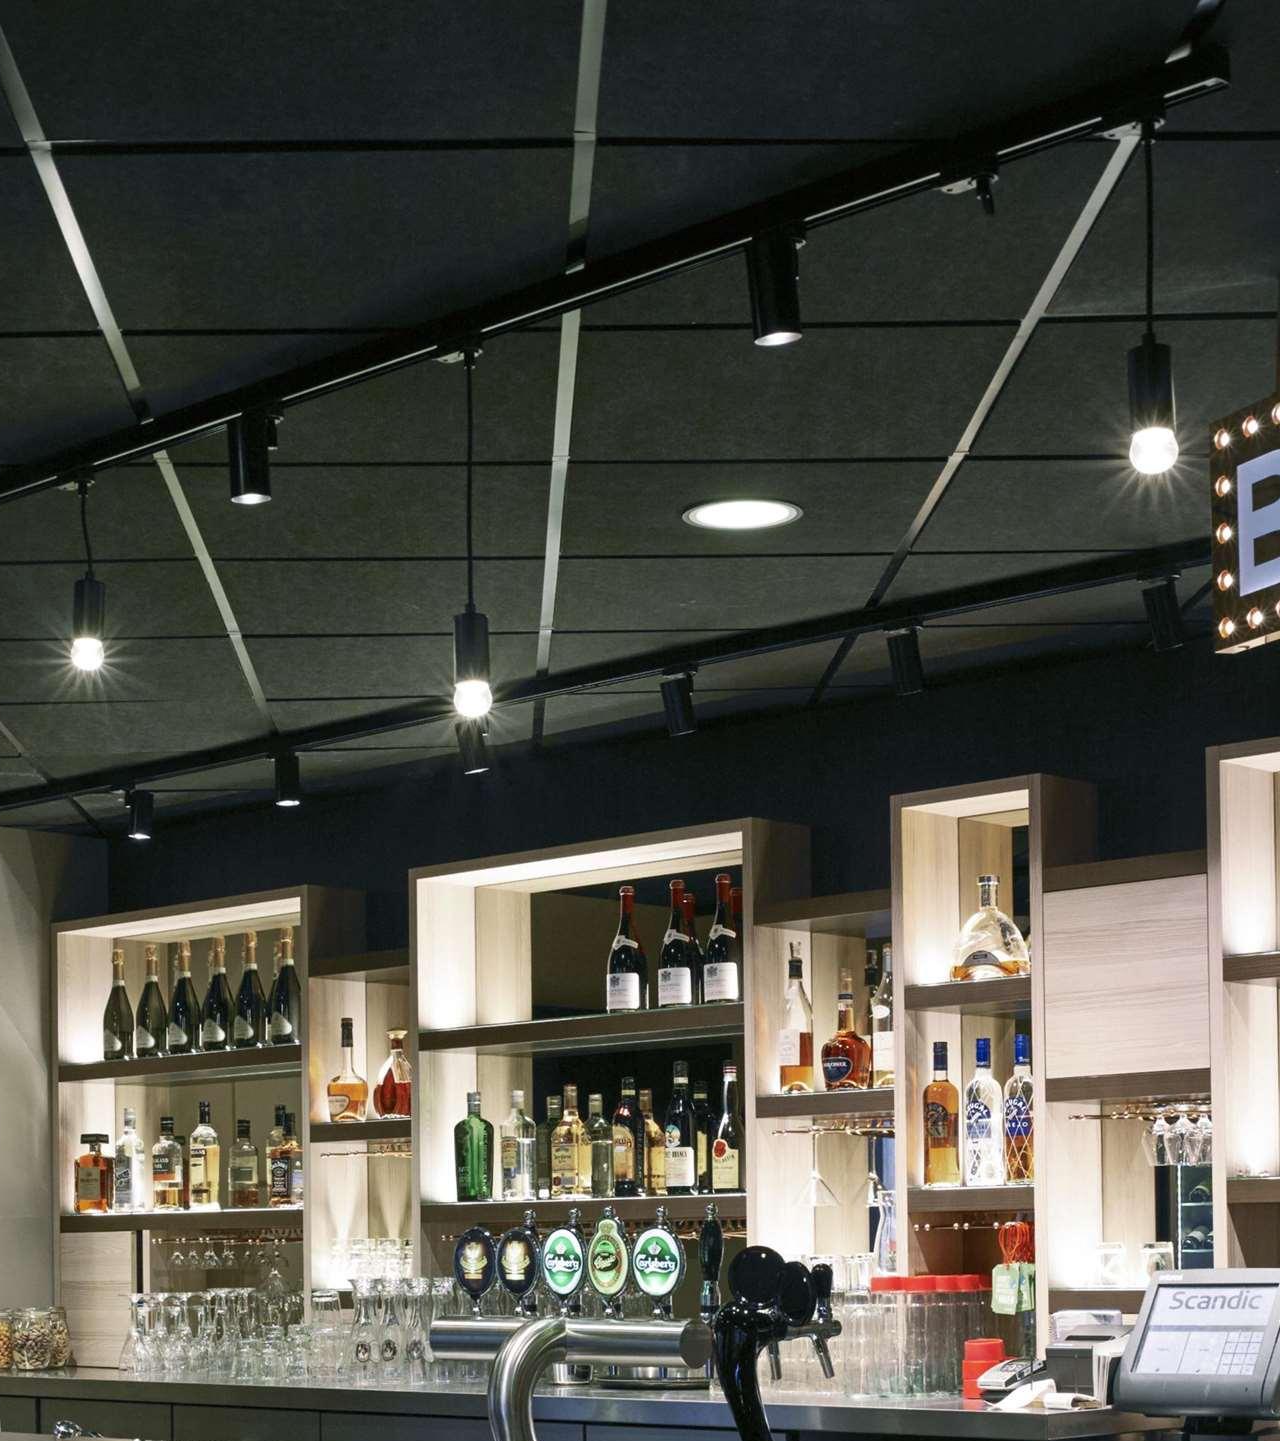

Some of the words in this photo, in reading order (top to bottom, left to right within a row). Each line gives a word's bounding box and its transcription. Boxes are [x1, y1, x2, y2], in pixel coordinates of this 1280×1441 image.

[545, 1253, 580, 1273] Carlsberg
[635, 1254, 676, 1274] Carlsberg
[1169, 1290, 1263, 1310] Scandic
